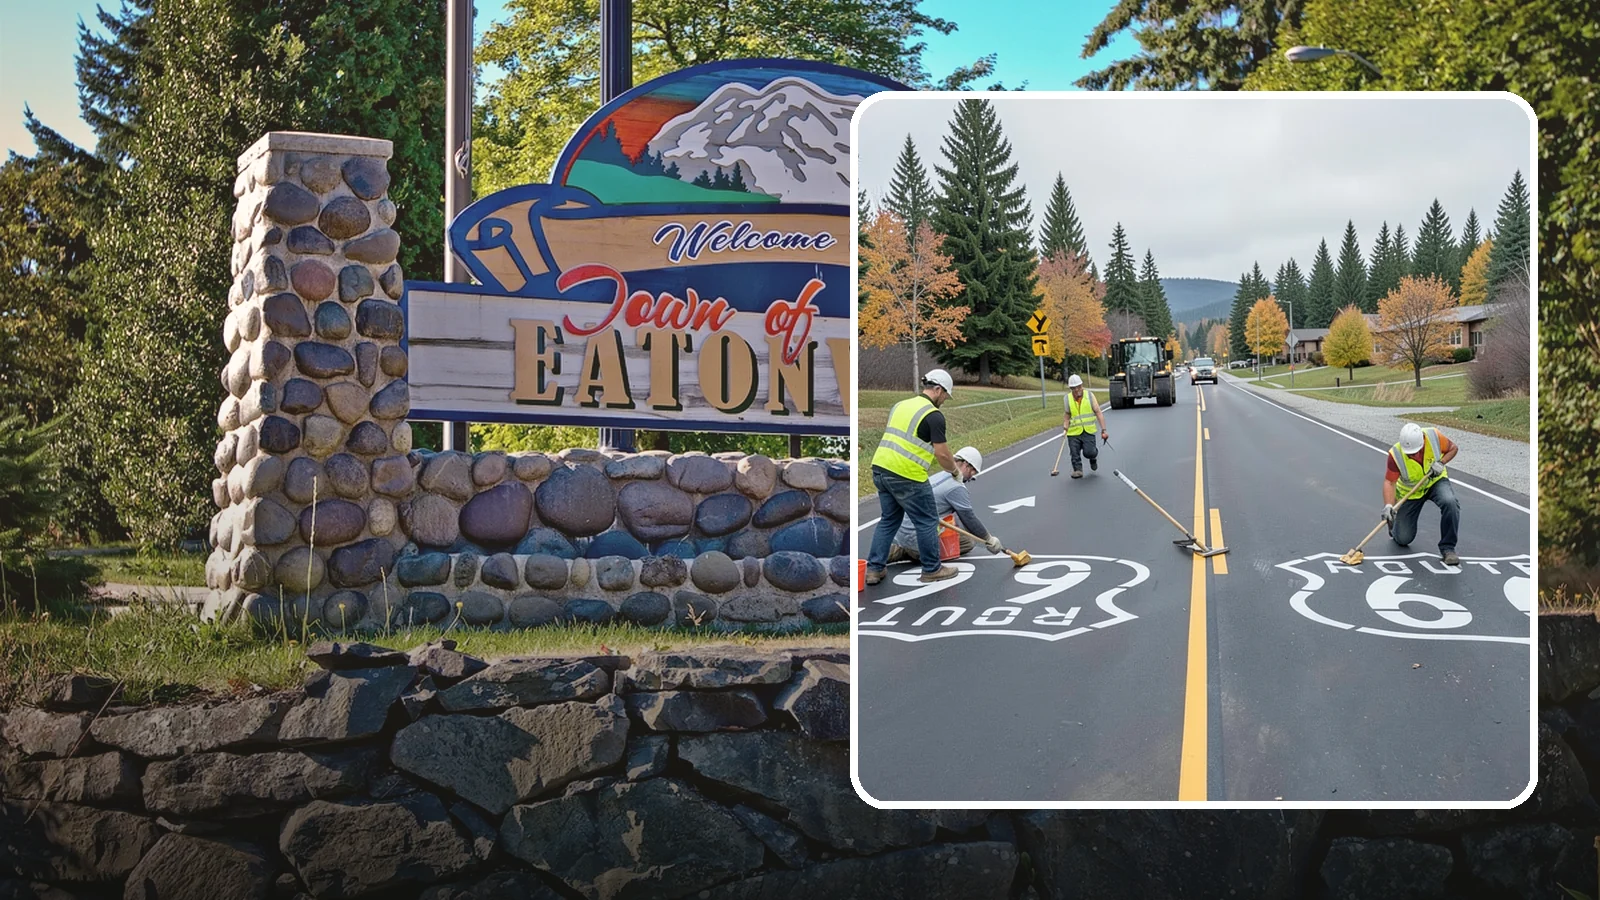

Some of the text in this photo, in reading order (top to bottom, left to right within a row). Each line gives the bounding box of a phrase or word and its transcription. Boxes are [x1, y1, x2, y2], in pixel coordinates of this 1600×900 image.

[654, 221, 836, 262] Welcome
[557, 264, 825, 364] Town of
[858, 606, 1081, 626] ROUT
[1365, 575, 1529, 629] 6
